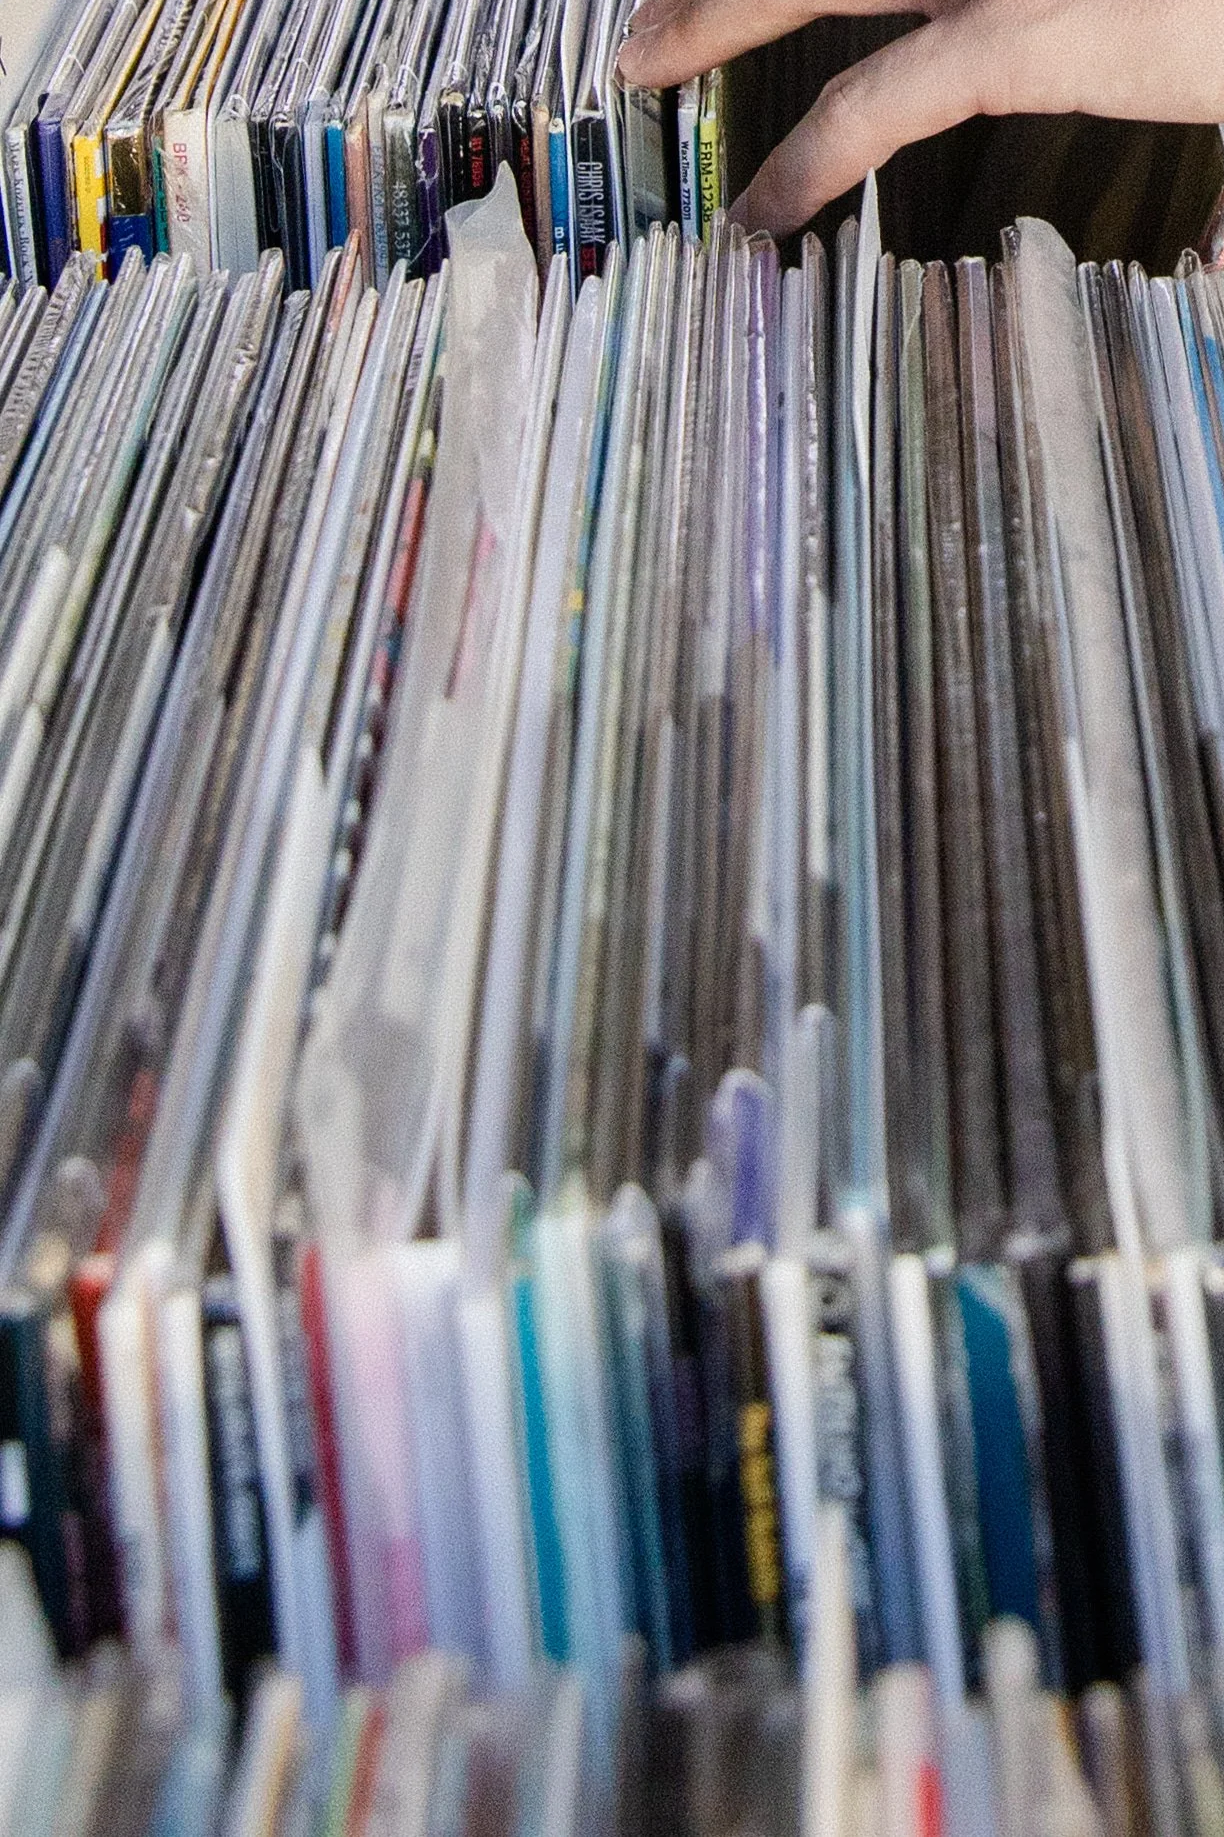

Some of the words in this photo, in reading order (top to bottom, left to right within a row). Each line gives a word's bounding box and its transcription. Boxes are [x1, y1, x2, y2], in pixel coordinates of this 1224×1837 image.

[577, 162, 604, 201] CHRIS
[681, 141, 690, 184] WaxTime
[682, 188, 692, 220] 772011
[579, 205, 606, 243] ISAAK
